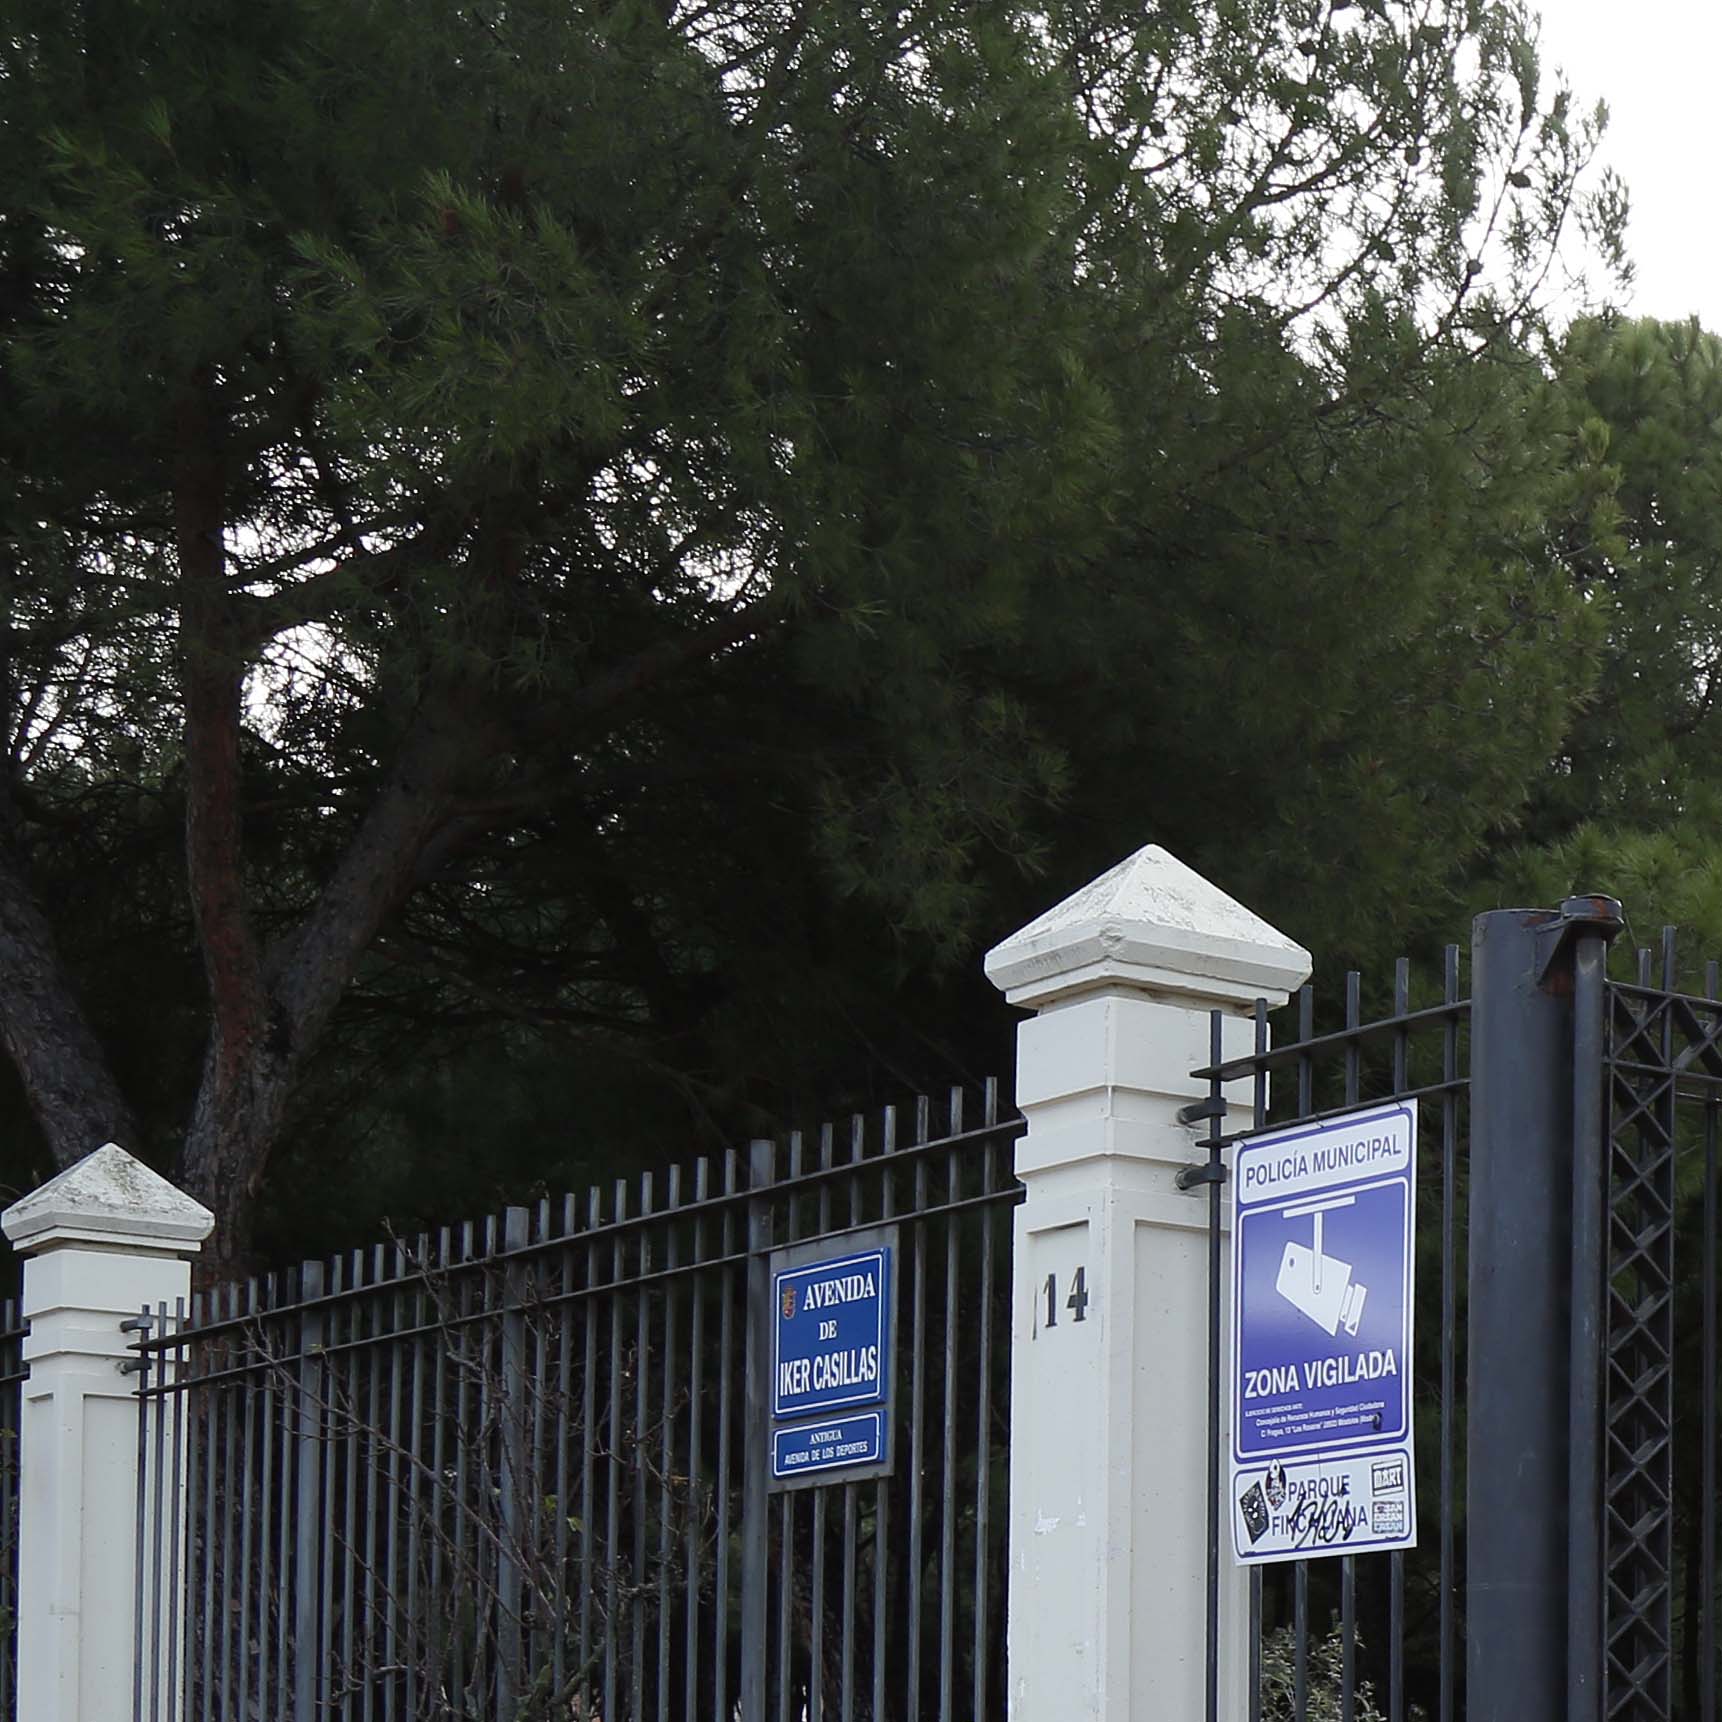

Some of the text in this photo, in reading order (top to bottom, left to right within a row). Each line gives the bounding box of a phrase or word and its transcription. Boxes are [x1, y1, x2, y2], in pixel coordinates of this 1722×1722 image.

[1246, 1134, 1402, 1188] POLICÍA MUNICIPAL
[803, 1272, 876, 1311] AVENIDA
[1043, 1266, 1089, 1328] 14
[819, 1320, 837, 1341] DE
[780, 1345, 877, 1397] IKER CASILLAS
[1244, 1349, 1398, 1399] ZONA VIGILADA
[811, 1449, 821, 1461] DE
[822, 1447, 834, 1459] LOS
[836, 1441, 868, 1457] DEPORTES
[1288, 1474, 1351, 1501] PARQUE
